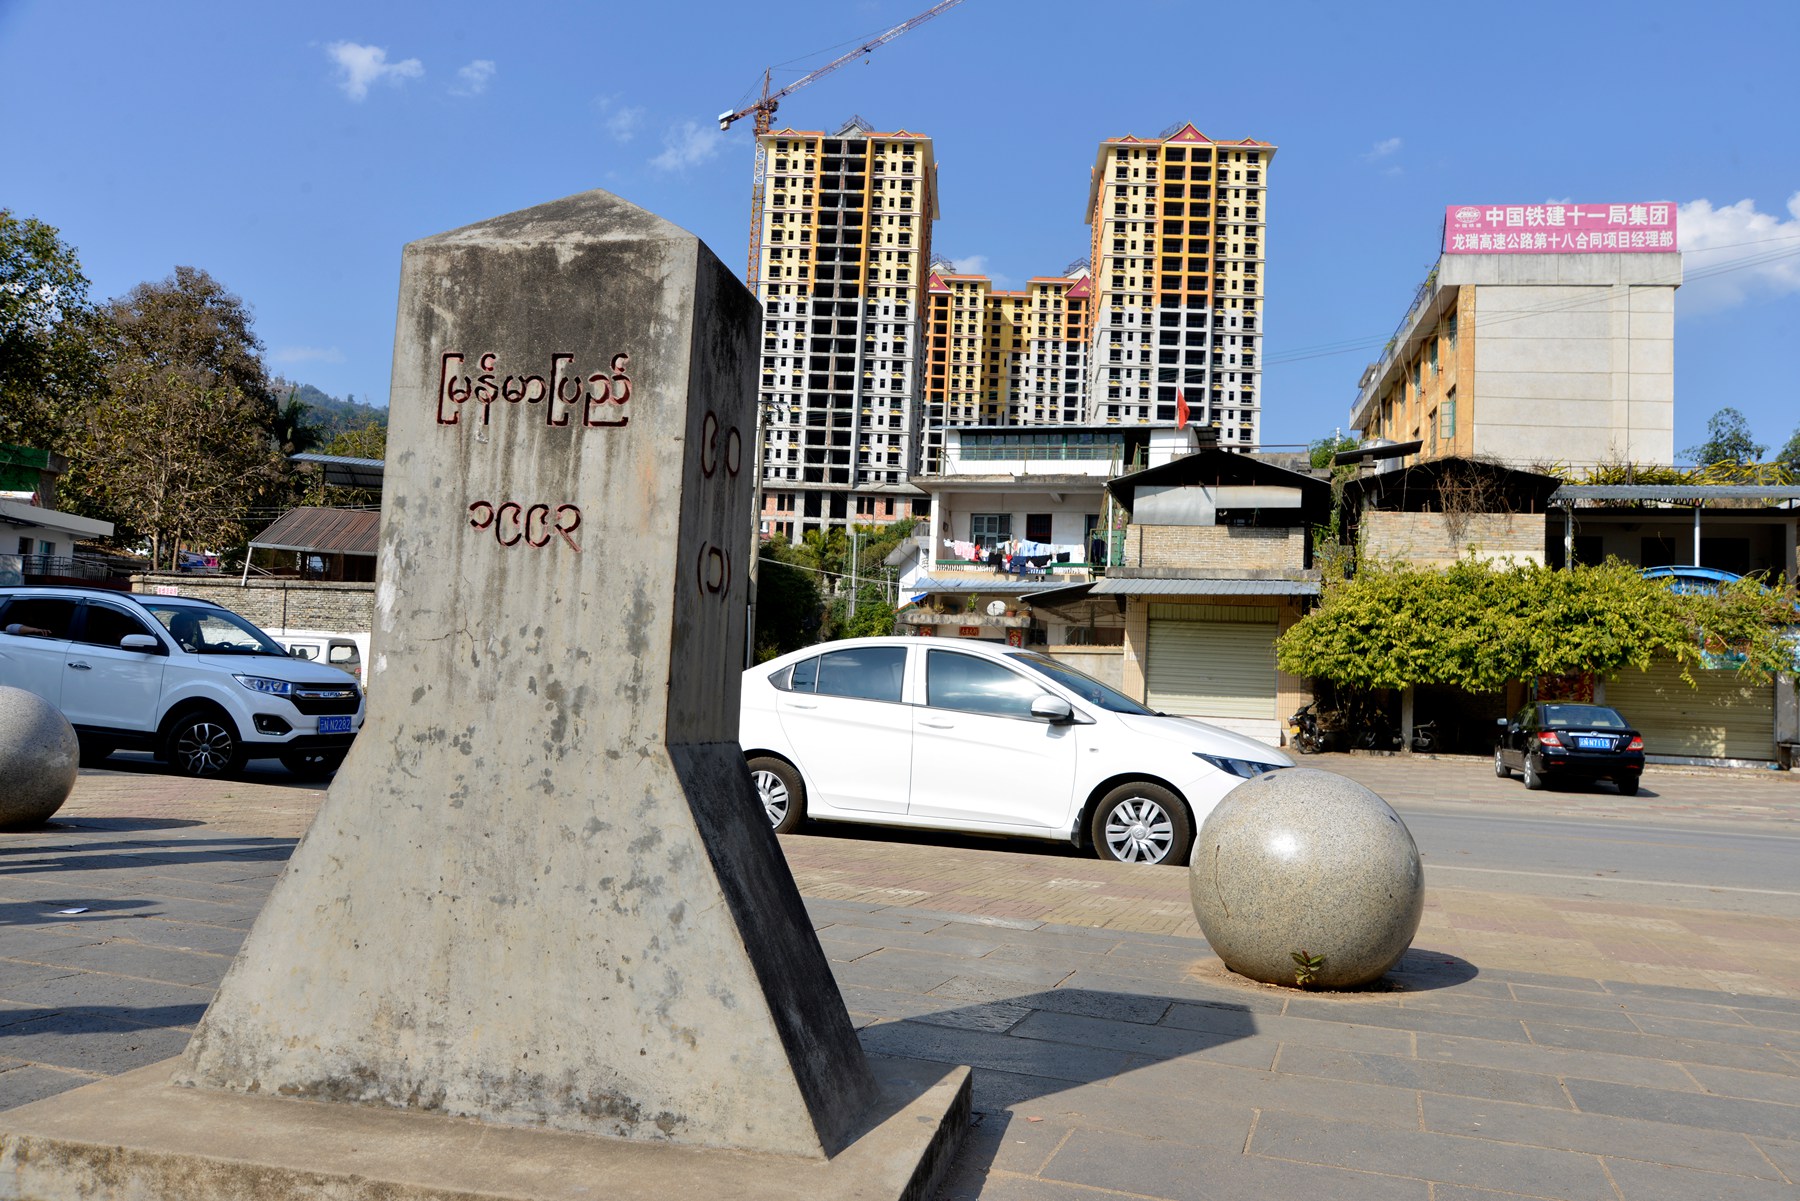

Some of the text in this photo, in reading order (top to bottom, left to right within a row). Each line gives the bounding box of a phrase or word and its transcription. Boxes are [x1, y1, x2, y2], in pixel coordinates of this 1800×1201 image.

[1485, 205, 1669, 227] 中国铁建十一局集团
[1452, 231, 1674, 250] 龙瑞高速公路第十八合同项目经理部
[469, 500, 582, 553] ၁၉၉၂
